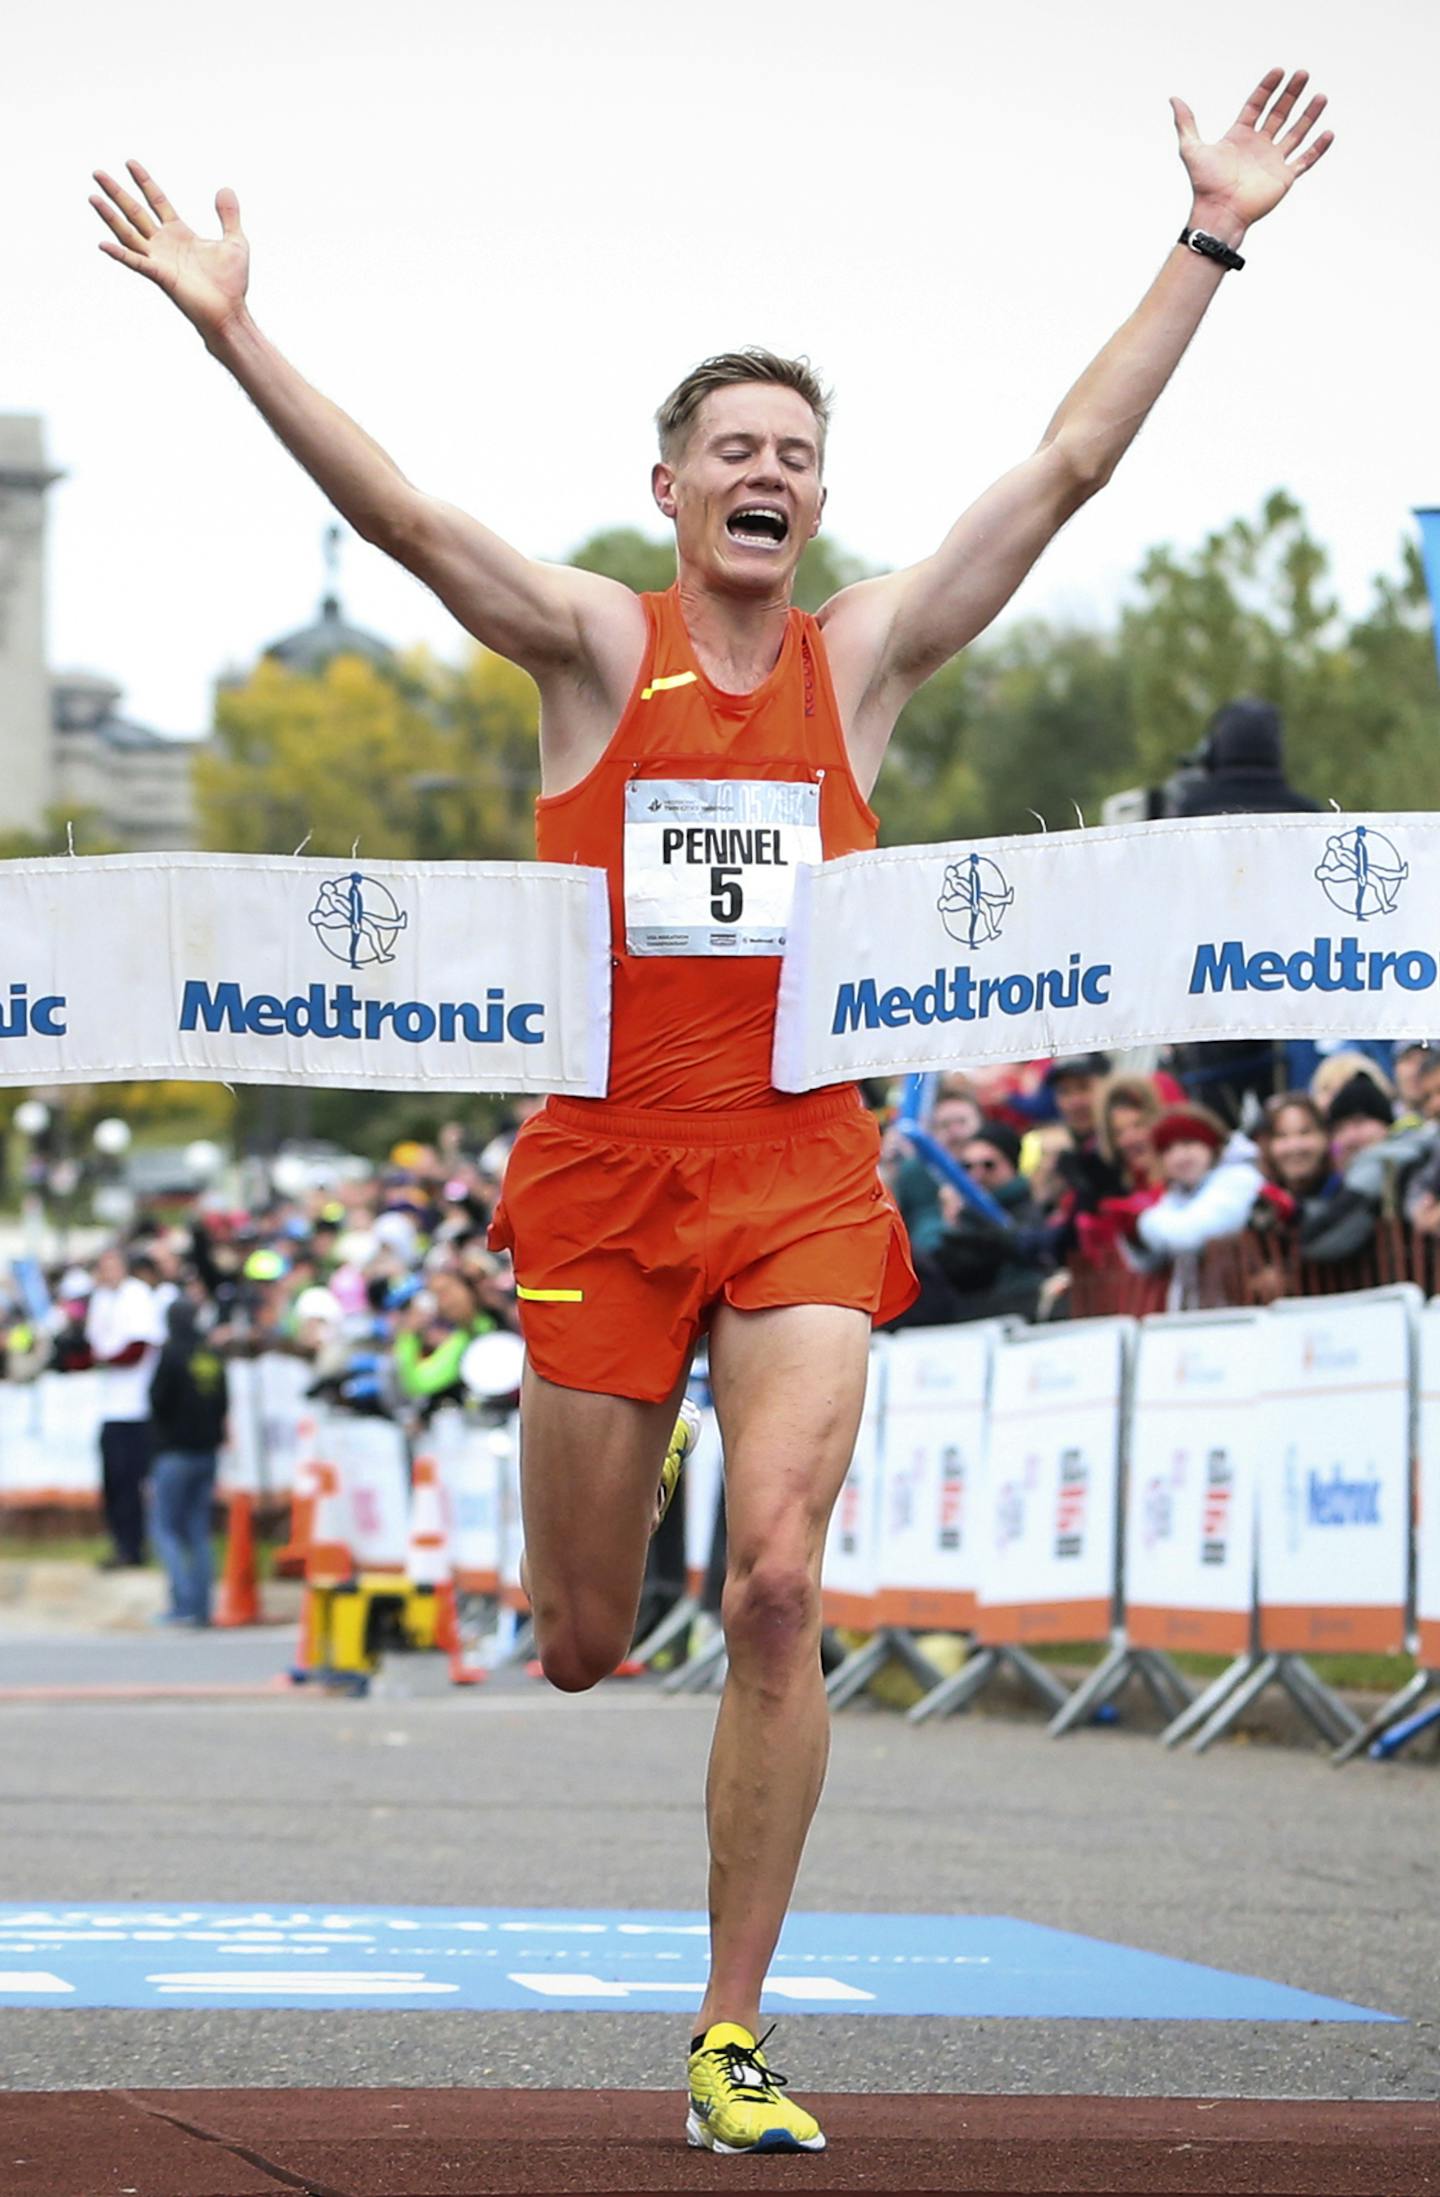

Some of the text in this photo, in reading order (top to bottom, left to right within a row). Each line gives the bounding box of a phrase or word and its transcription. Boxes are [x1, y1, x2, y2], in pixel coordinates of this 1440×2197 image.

[663, 828, 788, 865] PENNEL
[710, 867, 743, 923] 5
[180, 980, 544, 1044] Medtronic
[832, 940, 1111, 1034] Medtronic
